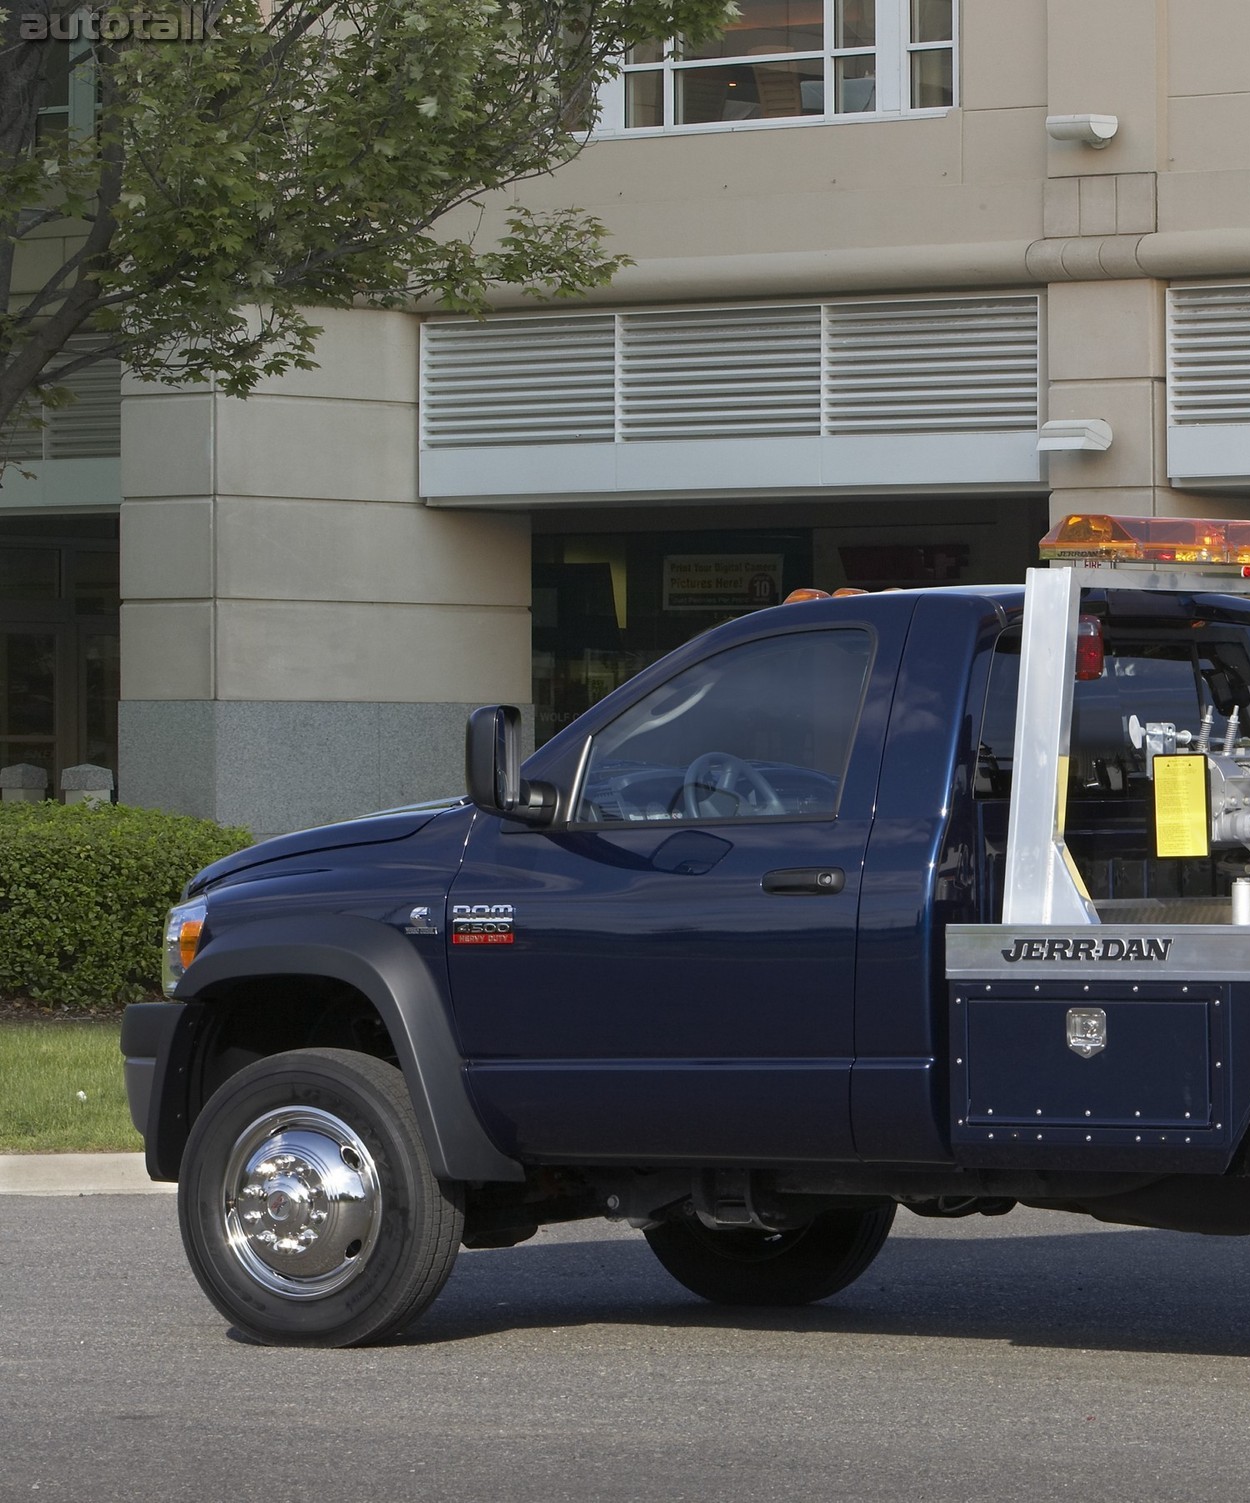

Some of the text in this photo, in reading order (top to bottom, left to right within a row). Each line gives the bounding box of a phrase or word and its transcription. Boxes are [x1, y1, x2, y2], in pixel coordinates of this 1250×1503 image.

[670, 562, 777, 574] Print Your Digital Camera
[671, 577, 743, 589] Pictures Here!
[753, 580, 770, 597] 10
[539, 712, 570, 722] WOLF
[457, 923, 510, 933] 4500
[459, 935, 485, 943] HEAVY
[1001, 938, 1175, 962] JERR-DAN
